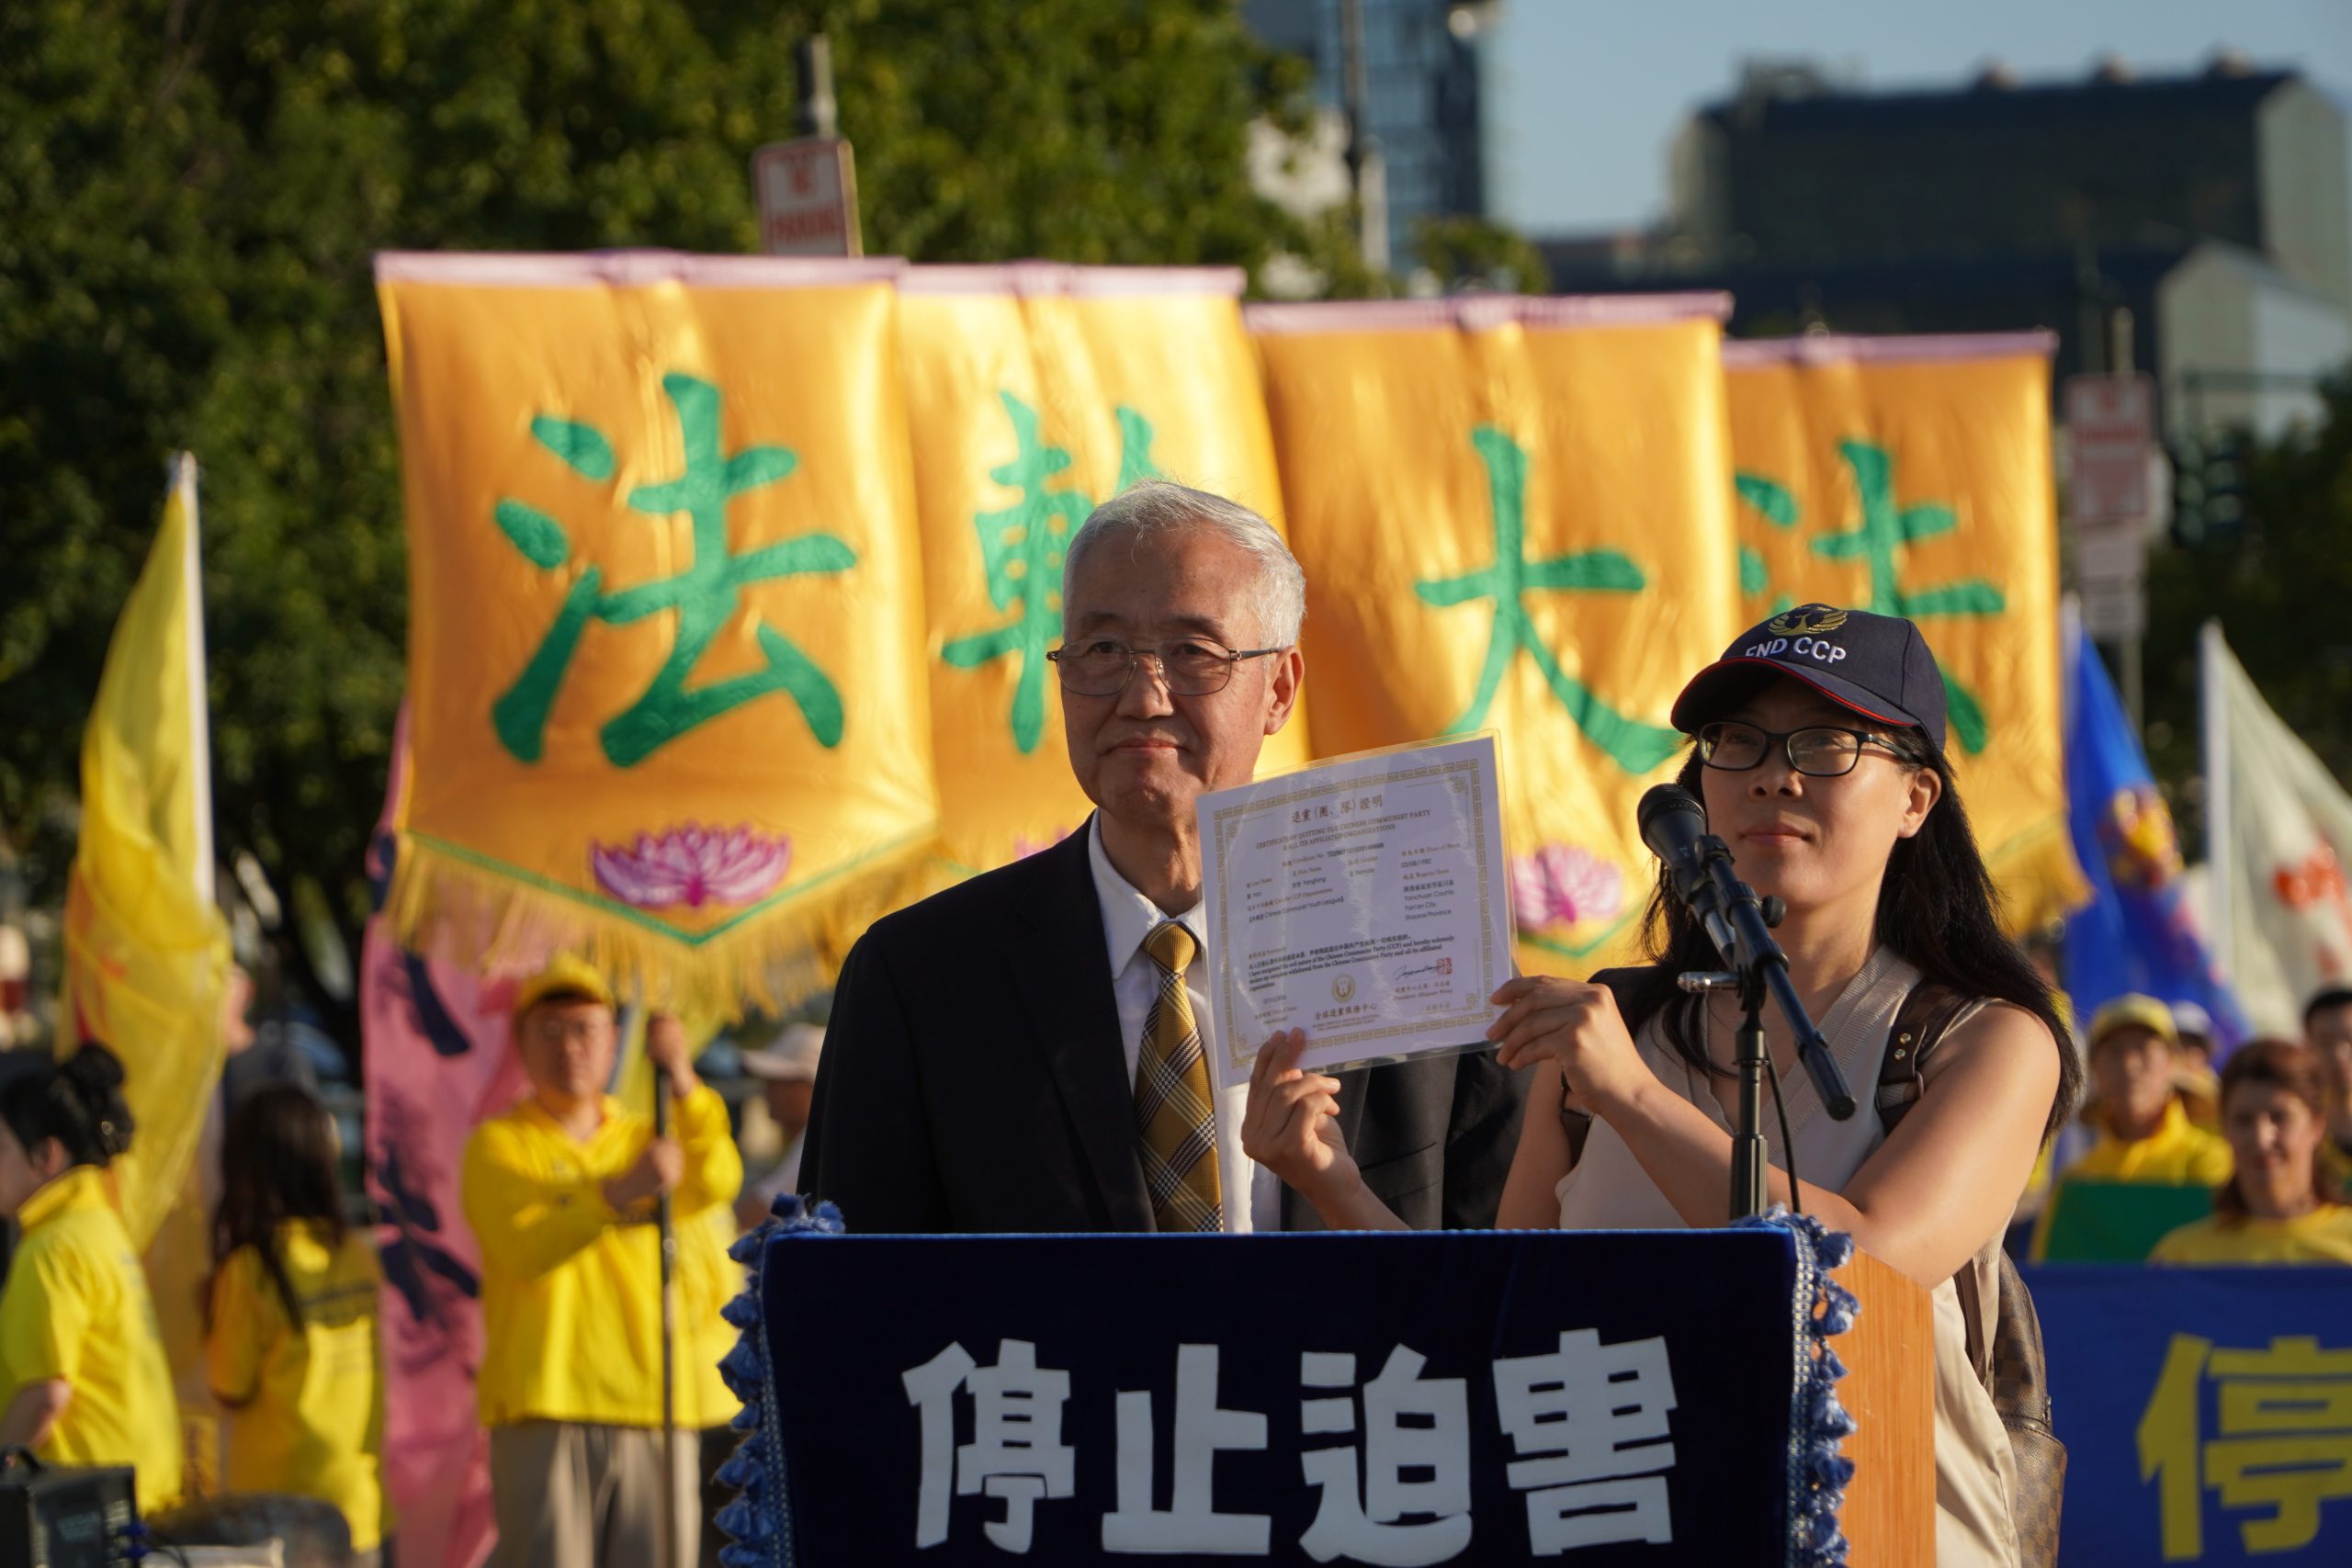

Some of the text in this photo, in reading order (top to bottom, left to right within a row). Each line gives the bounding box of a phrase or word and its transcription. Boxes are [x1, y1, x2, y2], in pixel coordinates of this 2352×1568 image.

[493, 372, 858, 768] 法
[1415, 426, 1686, 774] 大
[1746, 637, 1847, 663] END CCP
[1298, 828, 1326, 839] QUITTING
[1409, 809, 1430, 818] PARTY
[902, 1328, 1676, 1568] 停止迫害
